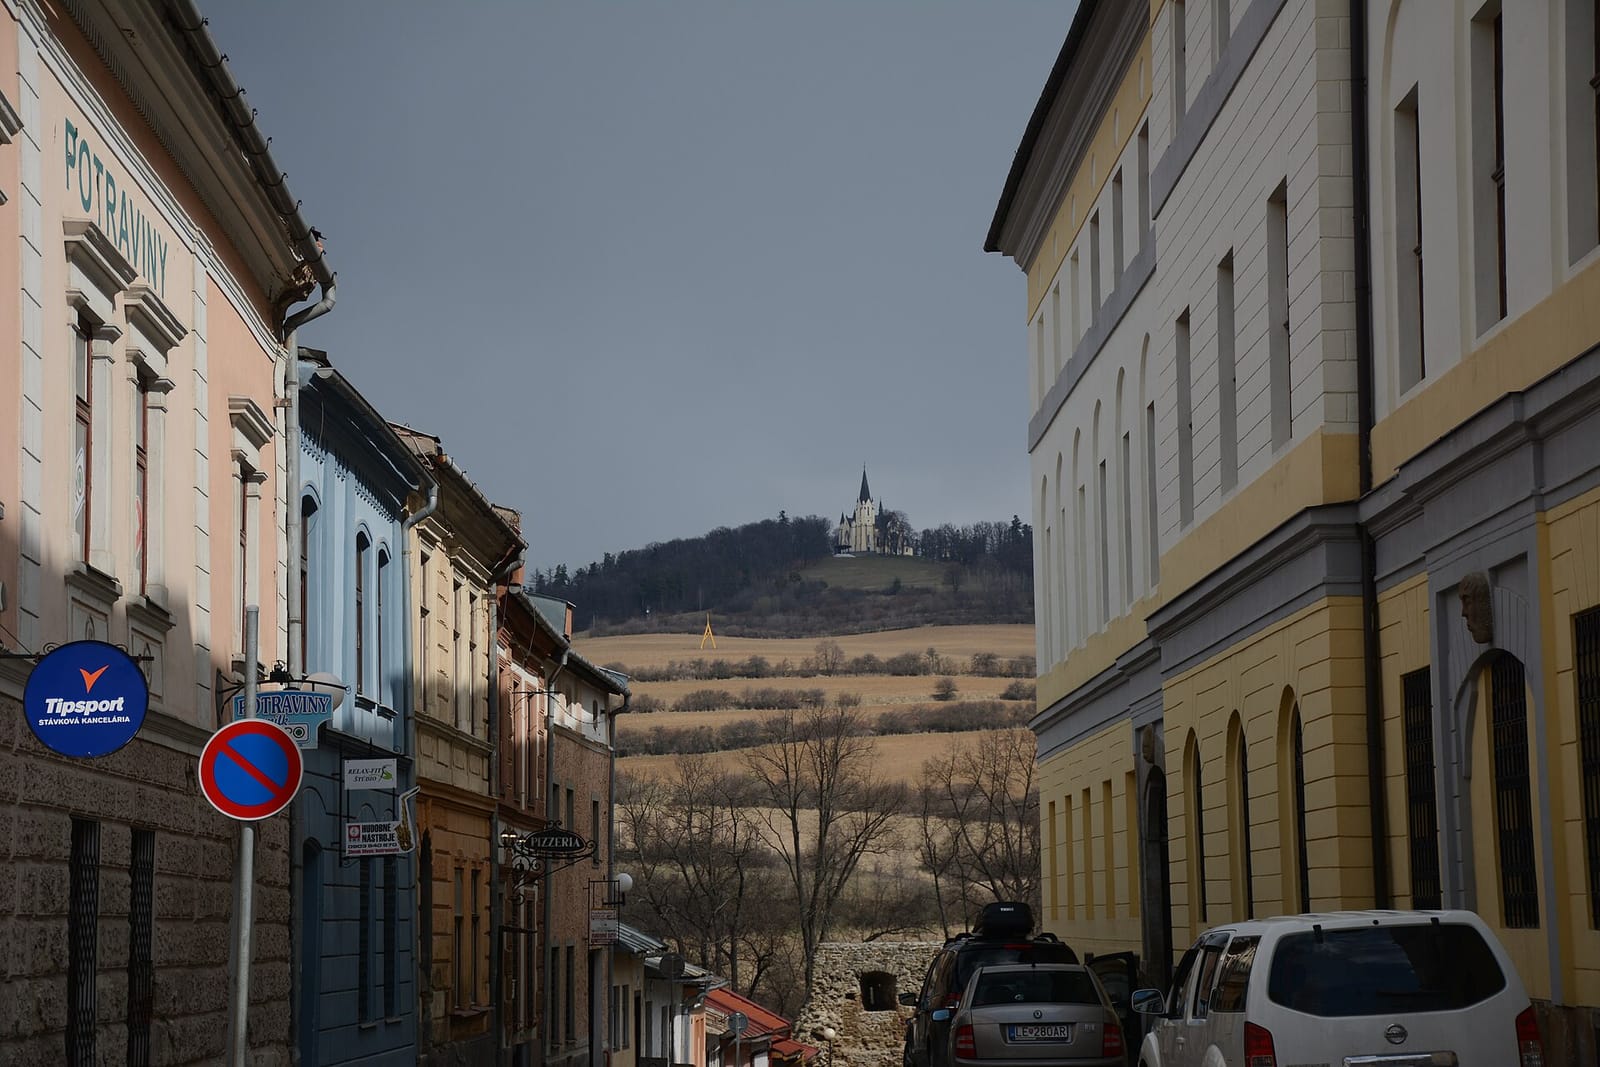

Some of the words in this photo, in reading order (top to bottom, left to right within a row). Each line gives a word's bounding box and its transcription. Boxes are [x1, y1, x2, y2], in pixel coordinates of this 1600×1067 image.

[65, 118, 168, 298] POTRAVINY
[45, 697, 125, 717] Tipsport
[38, 716, 80, 726] STÁVKOVÁ
[81, 715, 131, 724] KANCELÁRIA
[530, 837, 581, 848] PIZZERIA
